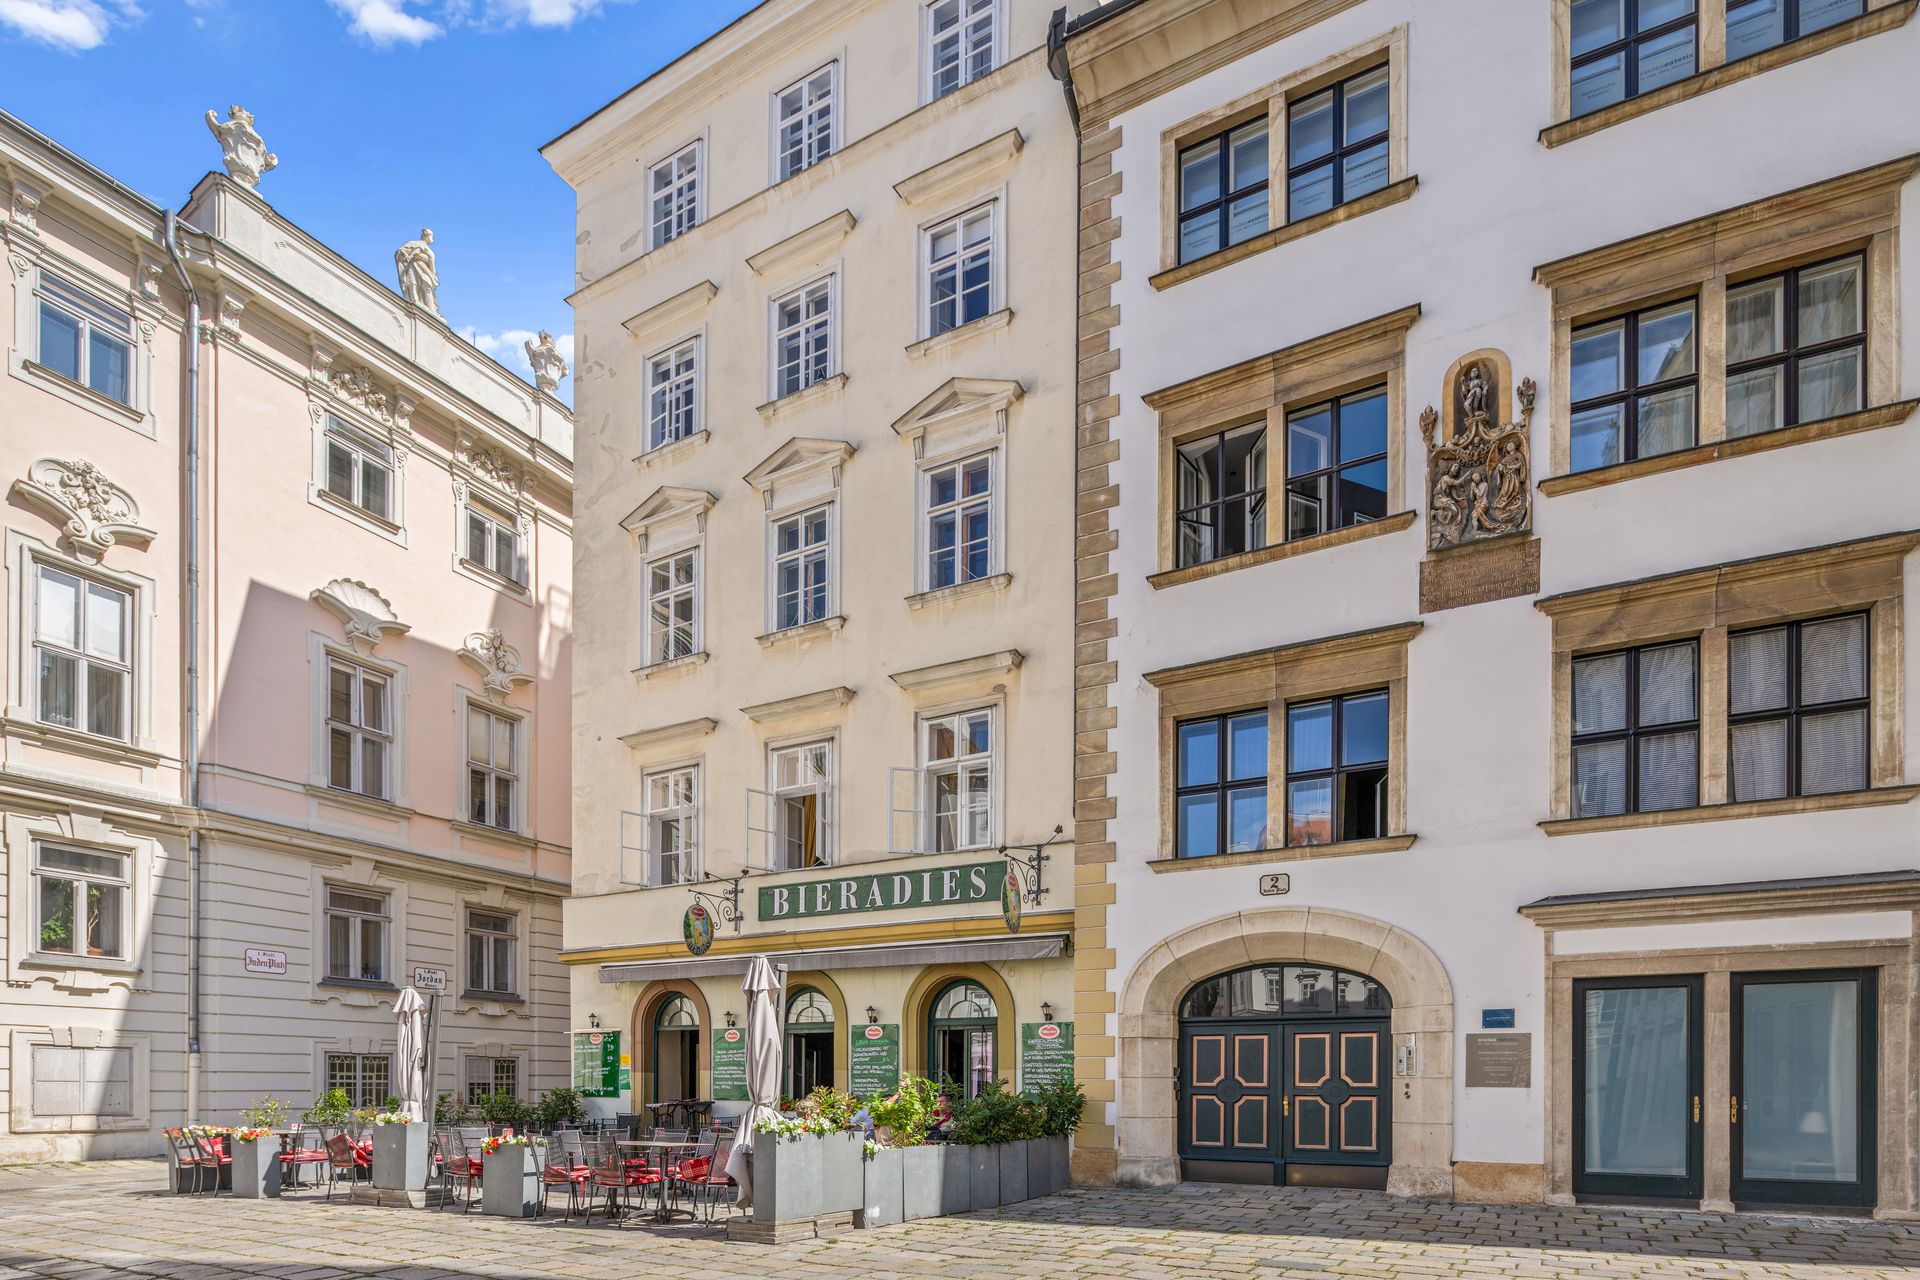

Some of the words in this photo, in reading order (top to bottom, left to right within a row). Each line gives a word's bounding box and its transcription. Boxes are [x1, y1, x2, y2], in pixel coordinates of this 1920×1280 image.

[1270, 876, 1279, 888] 2
[772, 865, 988, 917] BIERADIES
[416, 973, 443, 984] Jordan
